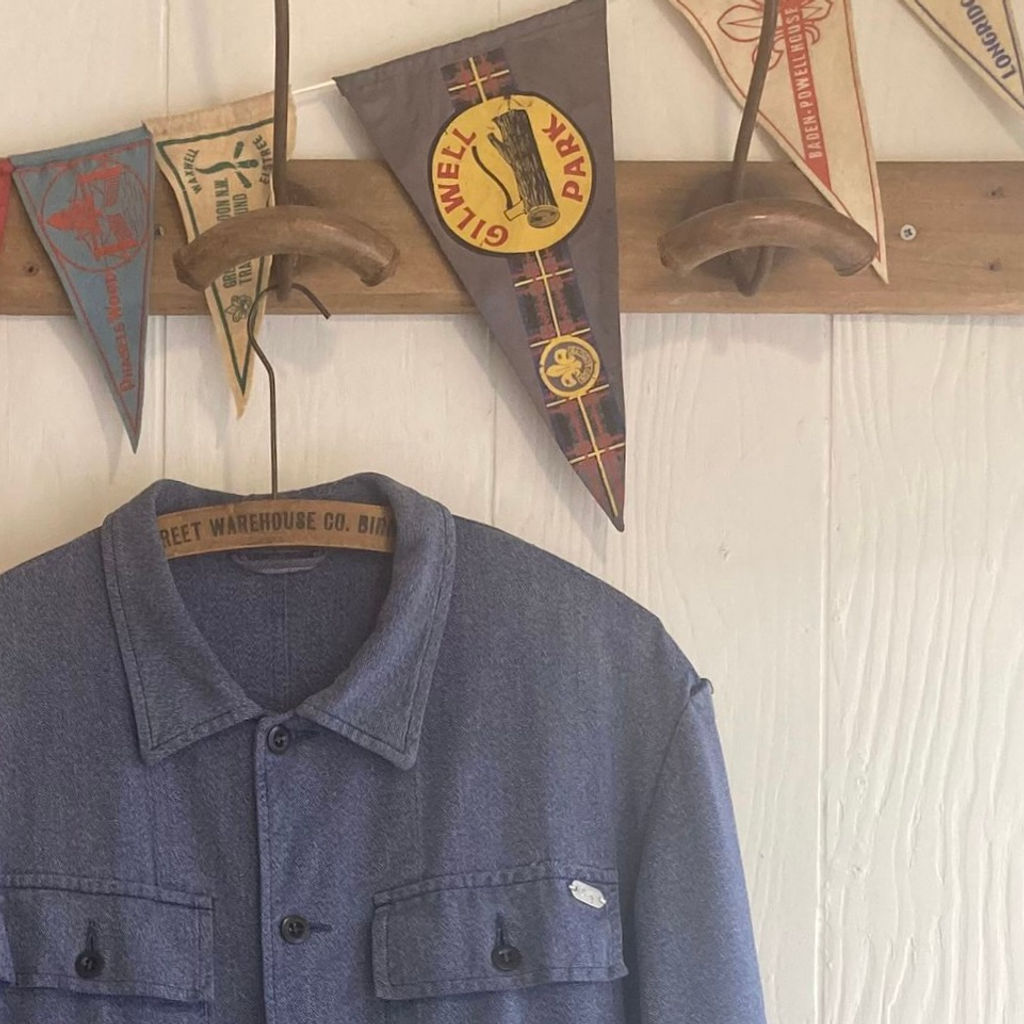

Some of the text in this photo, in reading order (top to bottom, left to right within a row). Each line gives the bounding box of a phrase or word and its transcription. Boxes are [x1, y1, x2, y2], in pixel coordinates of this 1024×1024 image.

[785, 6, 804, 52] HOUSE
[183, 148, 202, 195] WAXWELL
[541, 113, 587, 202] PARK
[437, 128, 509, 247] GILWELL
[209, 511, 317, 537] WAREHOUSE
[323, 512, 350, 532] CO.
